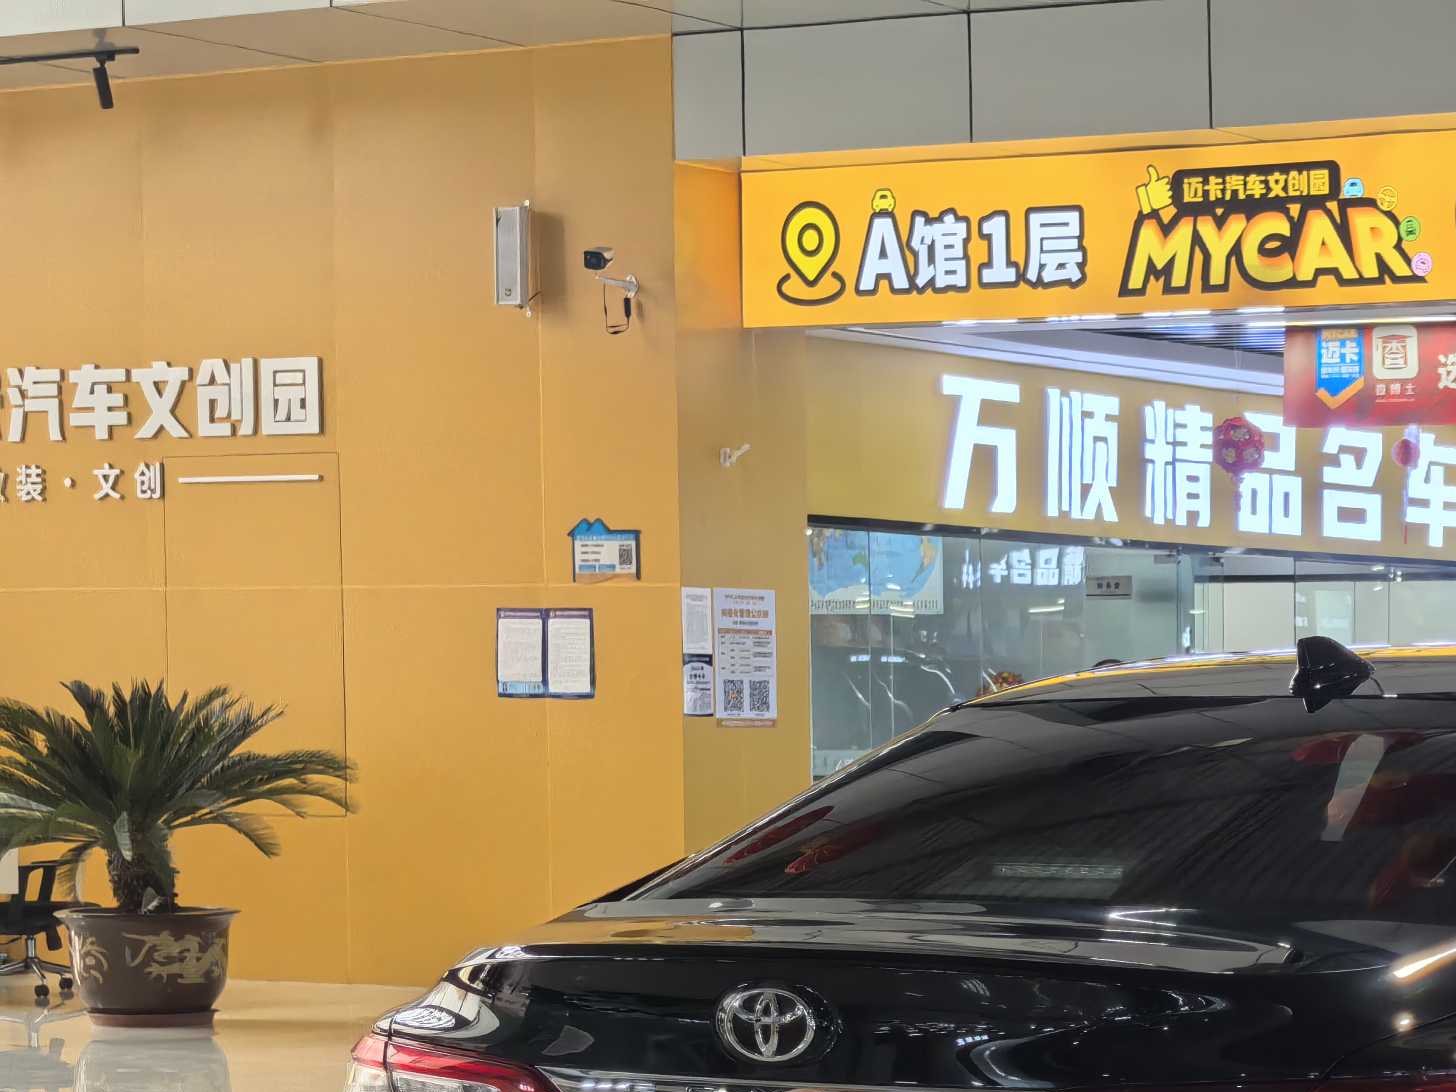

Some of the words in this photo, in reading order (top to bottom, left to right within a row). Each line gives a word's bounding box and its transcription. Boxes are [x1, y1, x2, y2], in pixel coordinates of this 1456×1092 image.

[1182, 169, 1330, 203] 迈卡汽车文创园
[857, 211, 1085, 292] A馆1层
[1123, 205, 1418, 293] MYCAR
[1321, 340, 1360, 364] 迈卡
[7, 356, 320, 443] 汽车文创园
